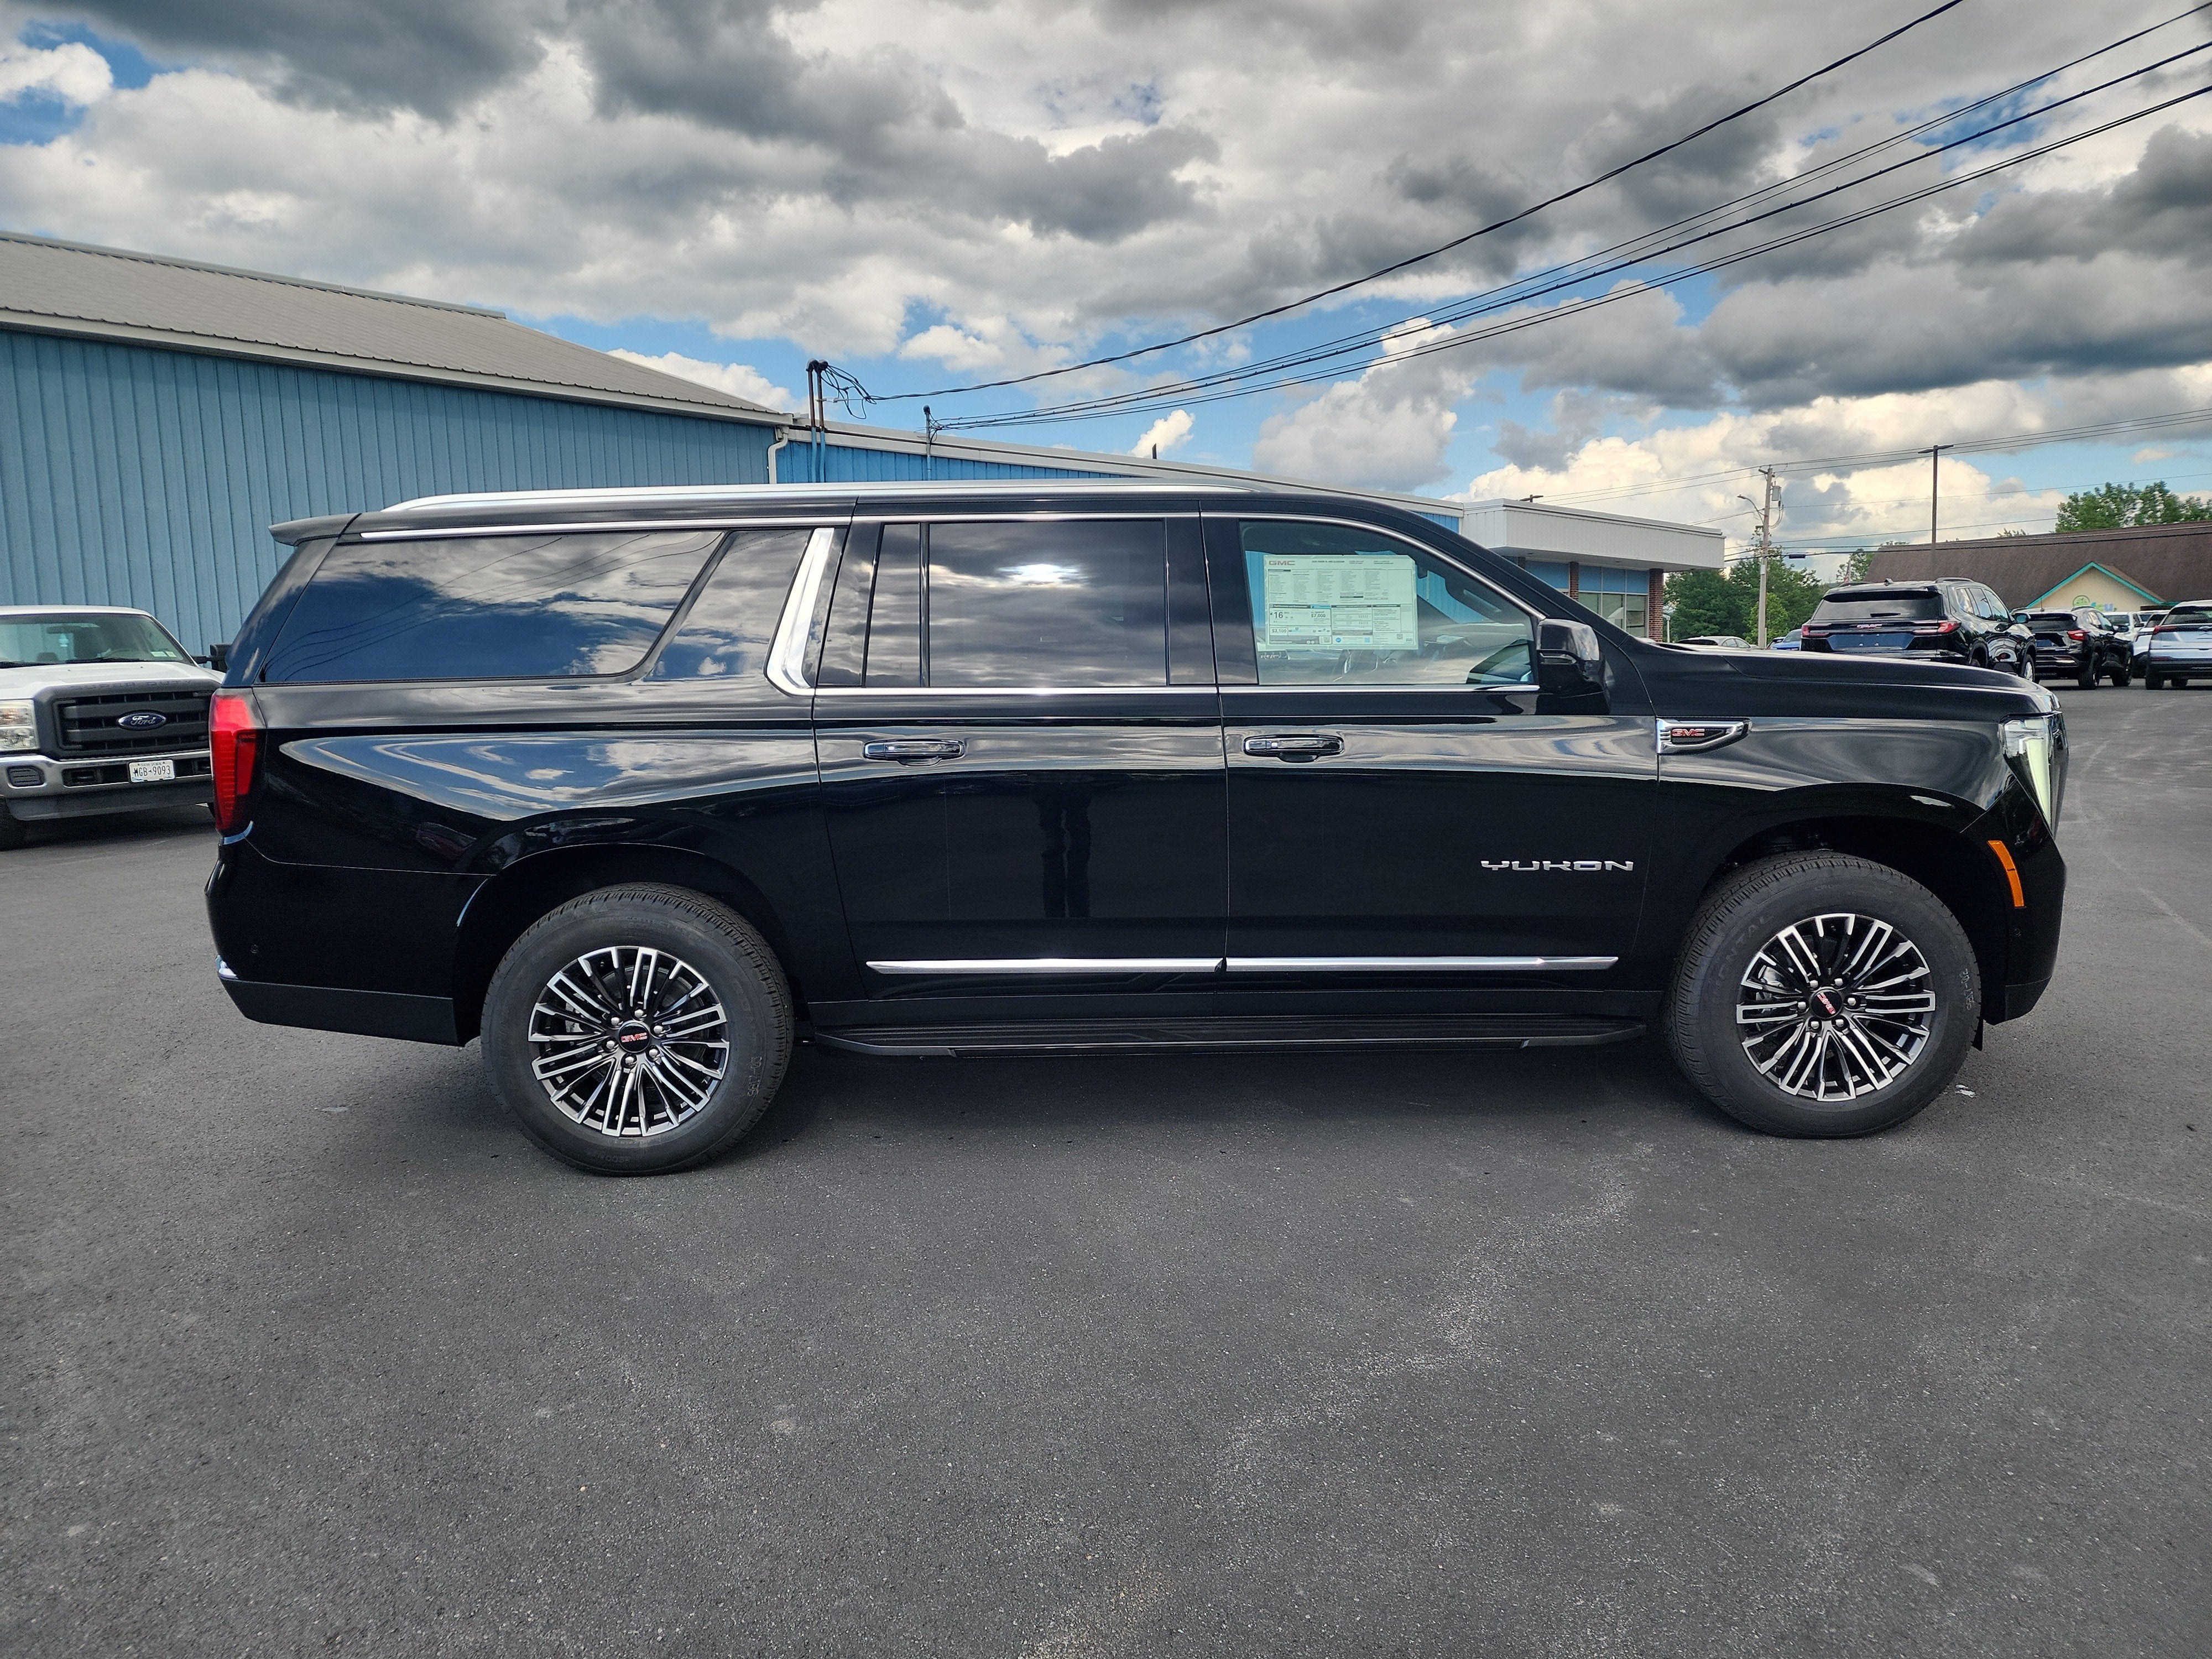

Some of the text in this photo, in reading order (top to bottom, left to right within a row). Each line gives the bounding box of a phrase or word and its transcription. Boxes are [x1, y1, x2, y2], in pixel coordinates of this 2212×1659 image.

[131, 715, 156, 725] Ford
[152, 765, 171, 775] 9093
[1480, 860, 1634, 871] YUKON
[1817, 992, 1836, 1015] GMC
[621, 1032, 648, 1042] GMC
